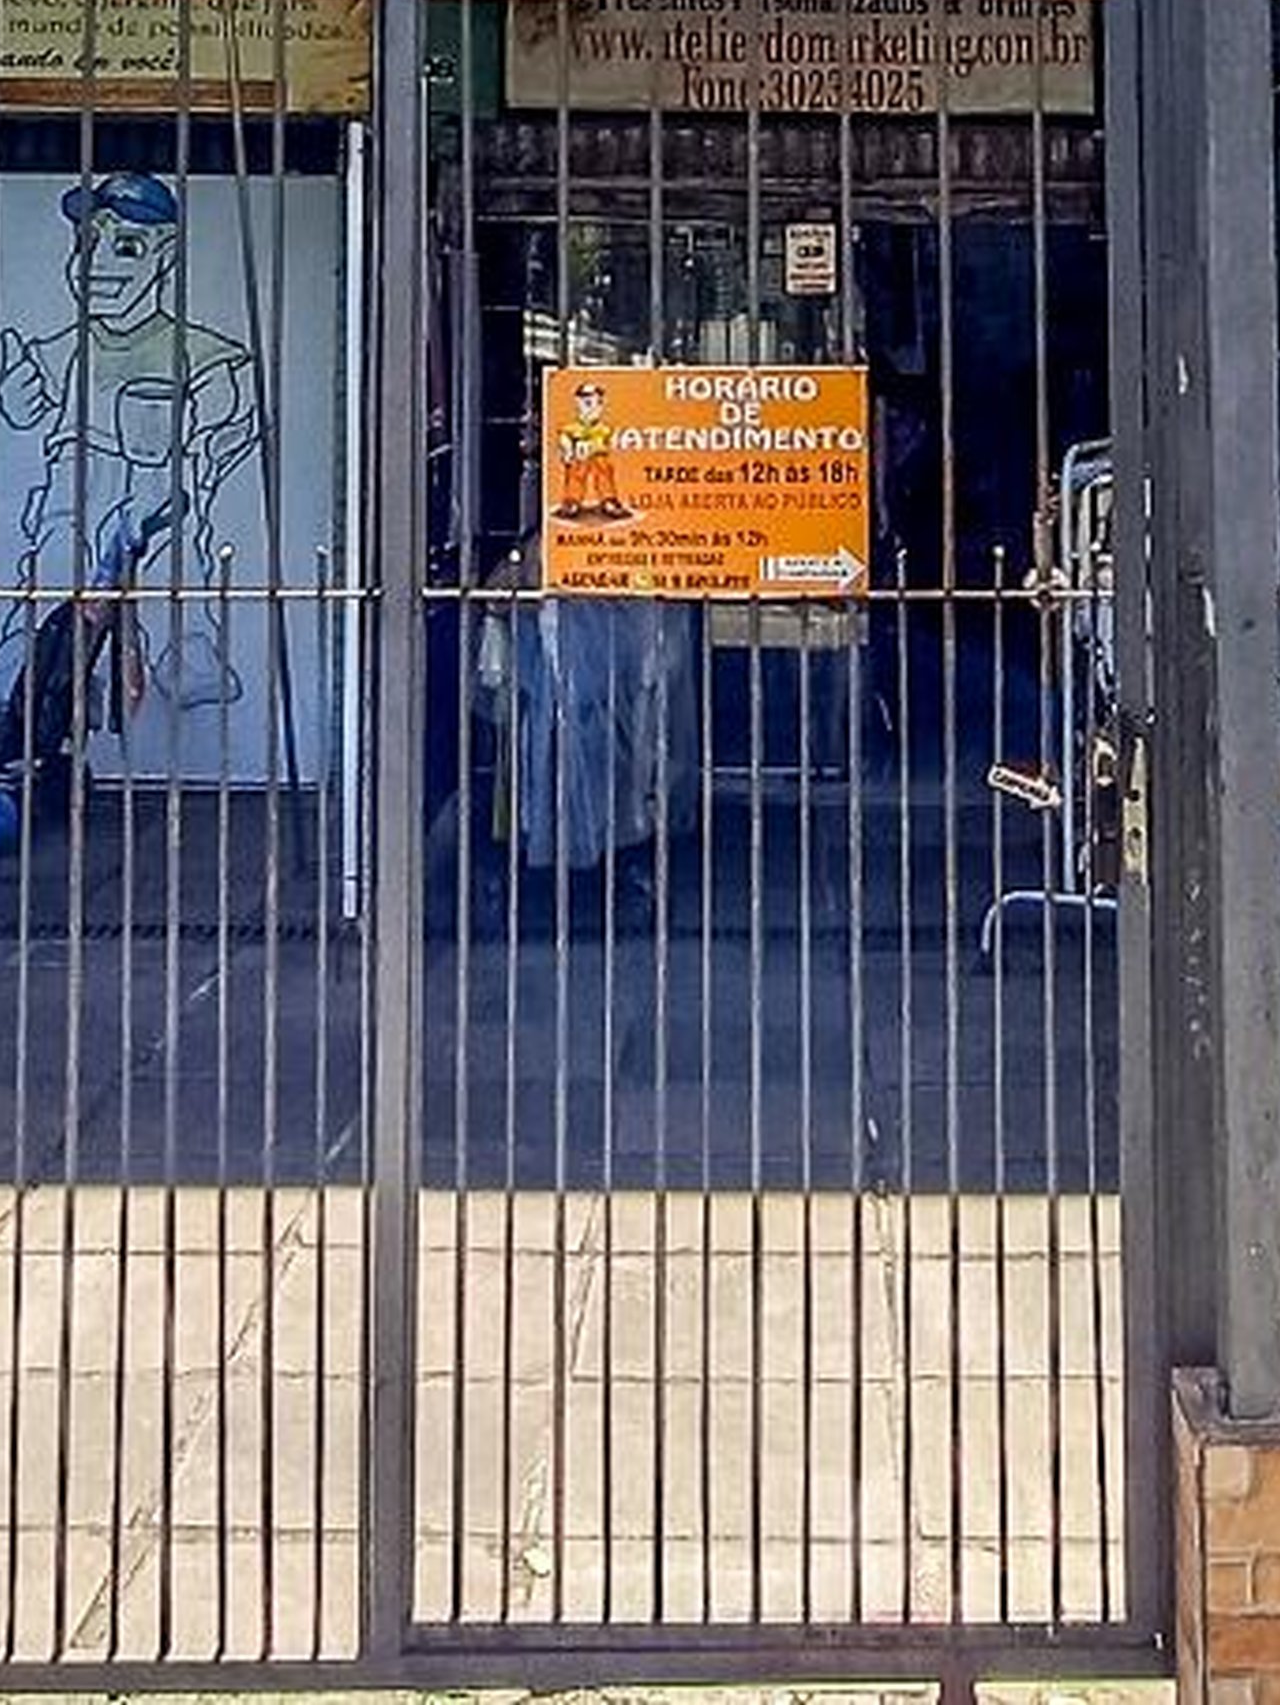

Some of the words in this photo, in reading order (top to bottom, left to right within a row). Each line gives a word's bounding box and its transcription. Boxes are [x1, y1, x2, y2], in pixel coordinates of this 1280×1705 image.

[664, 370, 819, 402] HORÁRIO
[720, 401, 763, 426] DE
[618, 426, 864, 452] ATENDIMENTO
[739, 460, 781, 484] 12h
[818, 458, 860, 484] 18h
